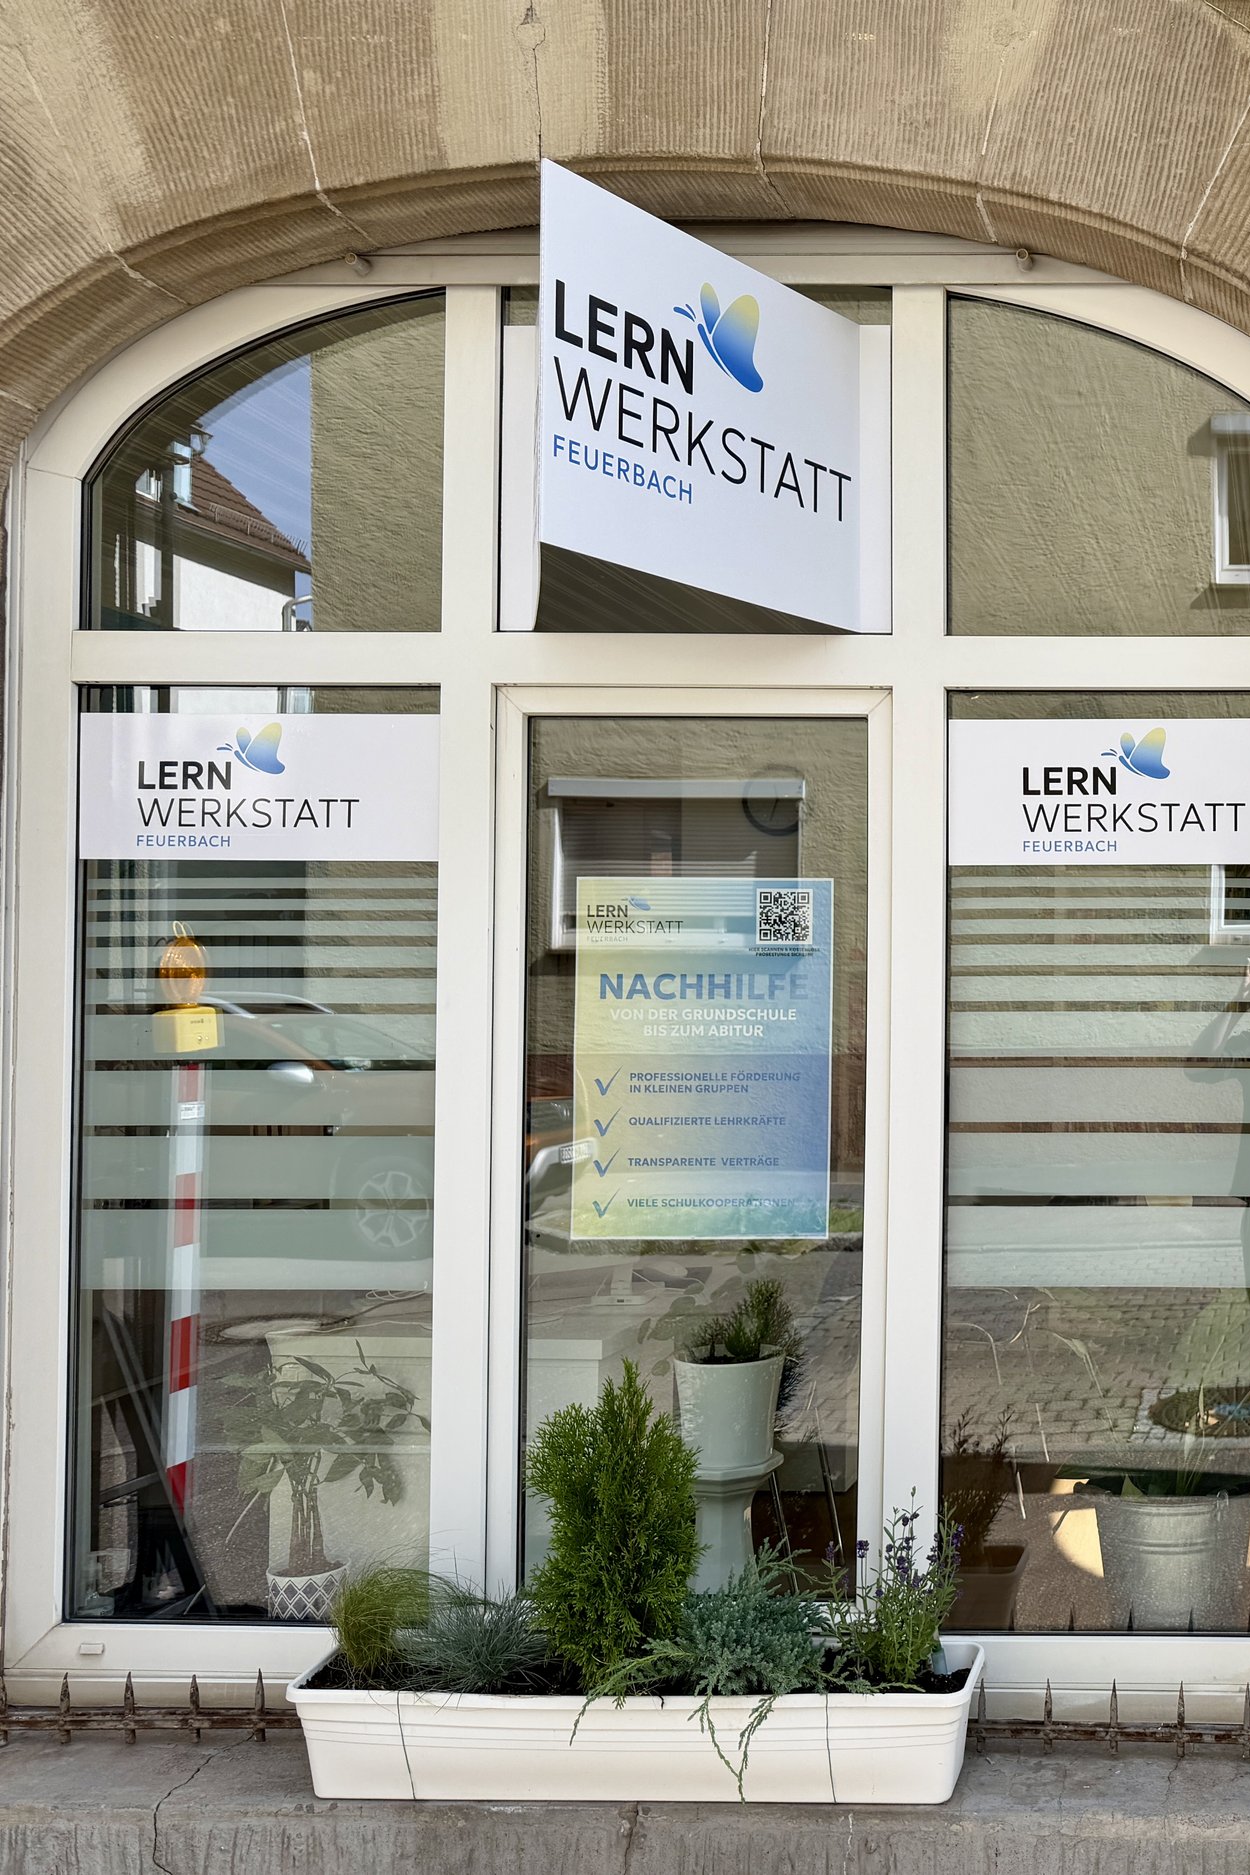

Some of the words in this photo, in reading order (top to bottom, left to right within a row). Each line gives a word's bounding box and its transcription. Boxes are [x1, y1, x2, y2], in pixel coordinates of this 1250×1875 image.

[555, 279, 694, 395] LERN
[554, 356, 852, 522] WERKSTATT
[553, 434, 693, 504] FEUERBACH
[138, 761, 232, 790] LERN
[1022, 767, 1117, 795] LERN
[137, 798, 359, 828] WERKSTATT
[1022, 803, 1246, 832] WERKSTATT
[136, 835, 231, 847] FEUERBACH
[1023, 840, 1117, 852] FEUERBACH
[587, 905, 628, 917] LERN
[587, 920, 683, 933] WERKSTATT
[600, 973, 809, 1000] NACHHILFE
[610, 1009, 644, 1021] VON
[648, 1009, 678, 1021] DER
[682, 1008, 797, 1021] GRUNDSCHULE
[644, 1025, 666, 1037] BIS
[671, 1025, 704, 1037] ZUM
[708, 1025, 763, 1037] ABITUR
[630, 1072, 728, 1081] PROFESSIONELLE
[731, 1070, 800, 1082] FÖRDERUNG
[630, 1084, 640, 1093] IN
[644, 1084, 692, 1093] KLEINEN
[695, 1084, 748, 1093] GRUPPEN
[629, 1116, 711, 1126] QUALIFIZIERTE
[715, 1114, 786, 1126] LEHRKRÄFTE
[628, 1158, 716, 1167] TRANSPARENTE
[721, 1155, 779, 1167] VERTRÄGE
[627, 1198, 657, 1208] VIELE
[661, 1198, 794, 1208] SCHULKOOPERATIONEN
